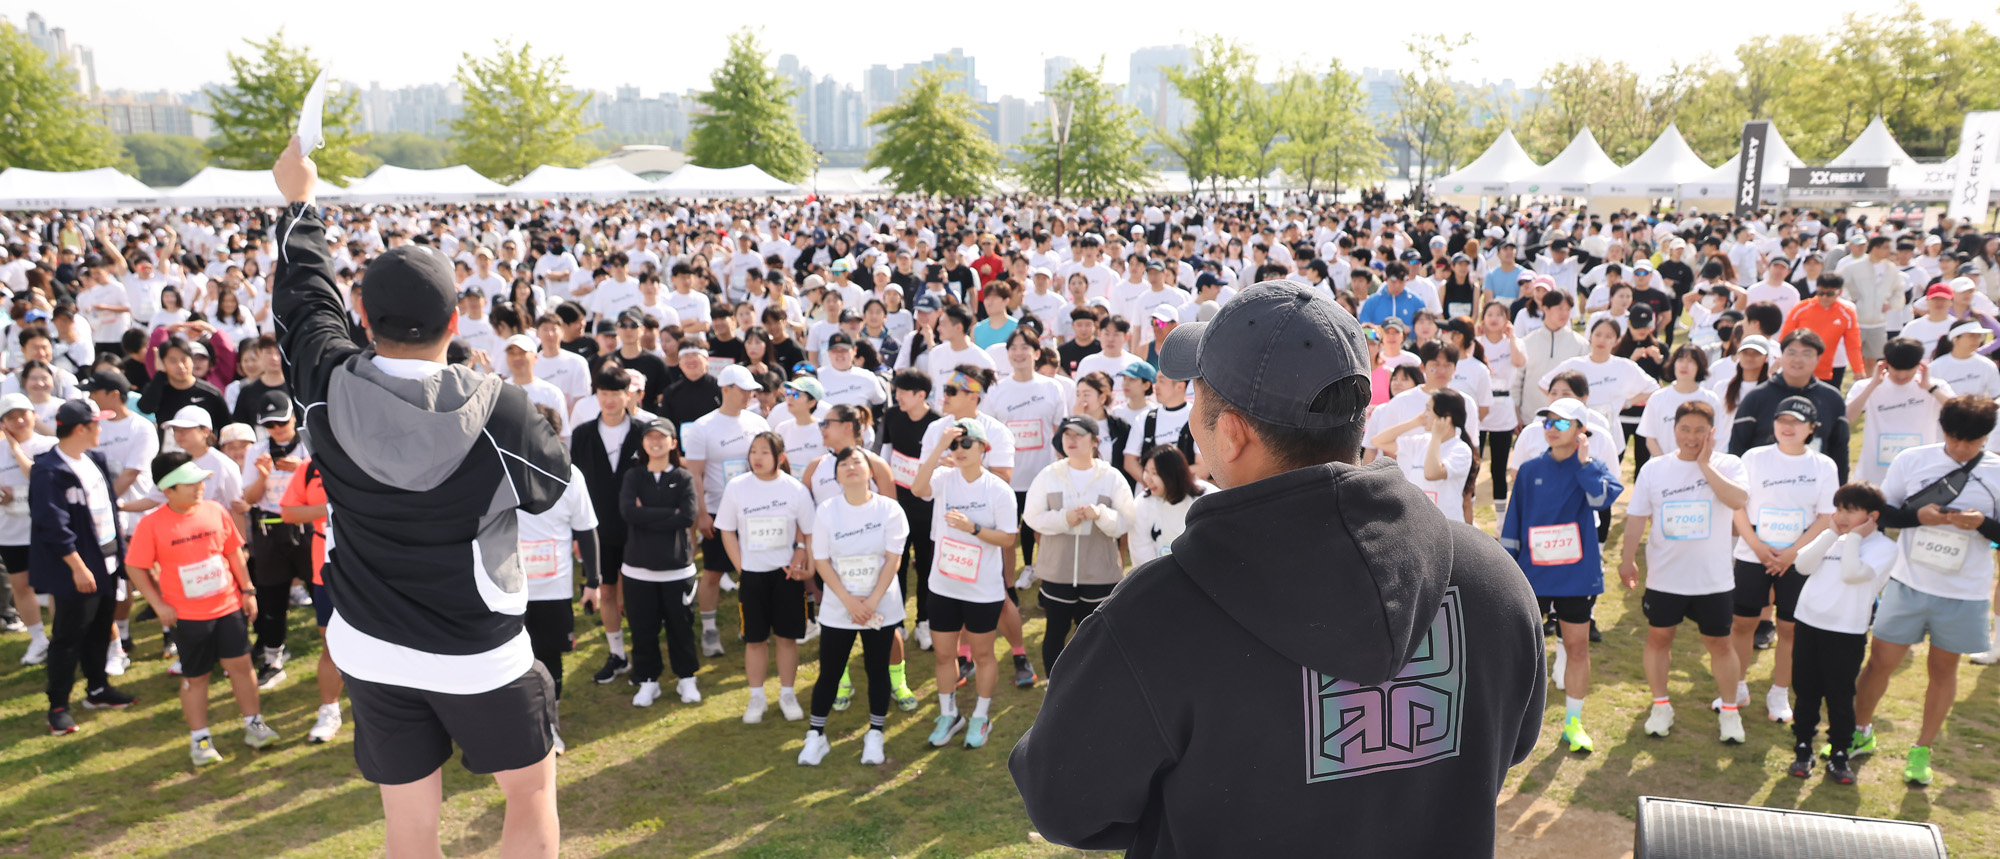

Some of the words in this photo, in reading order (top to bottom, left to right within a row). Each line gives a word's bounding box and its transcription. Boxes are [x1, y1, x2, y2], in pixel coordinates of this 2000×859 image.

[1744, 137, 1759, 180] REXY
[1970, 131, 1985, 177] REXY
[1830, 172, 1865, 183] REXY
[1762, 477, 1797, 488] Burning
[1797, 475, 1817, 484] Run
[1661, 484, 1696, 498] Burning
[1674, 514, 1705, 524] 7065
[758, 527, 784, 536] 5173
[834, 527, 864, 541] Burning
[864, 521, 882, 532] Run
[1769, 522, 1800, 532] 8065
[1544, 537, 1574, 549] 3737
[1925, 540, 1961, 557] 5093
[947, 552, 975, 567] 3456
[848, 567, 875, 577] 6387
